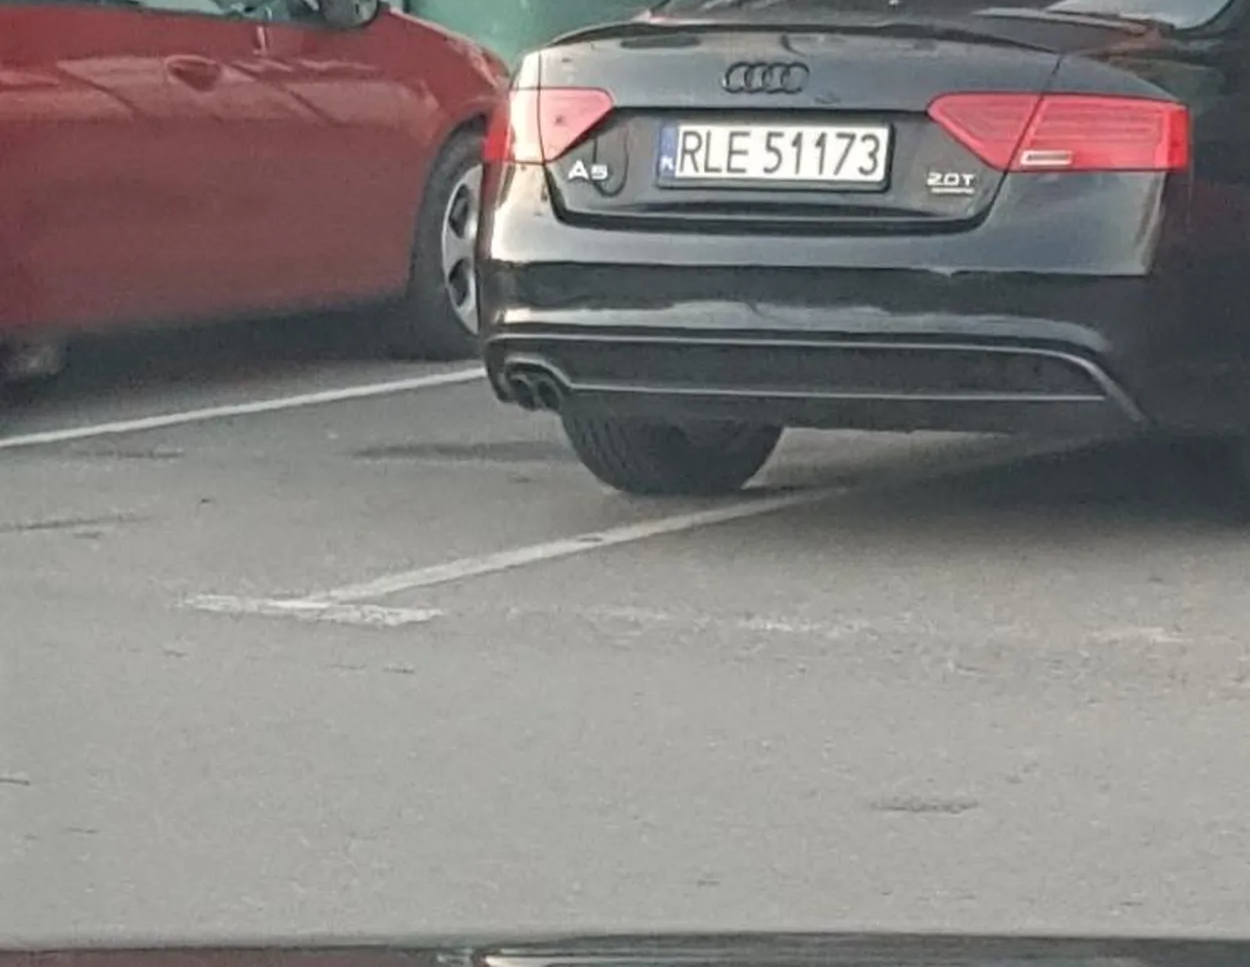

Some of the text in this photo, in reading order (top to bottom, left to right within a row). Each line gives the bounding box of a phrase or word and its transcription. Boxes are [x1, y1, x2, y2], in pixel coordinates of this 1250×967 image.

[568, 159, 608, 181] A5
[679, 130, 881, 177] RLE 51173
